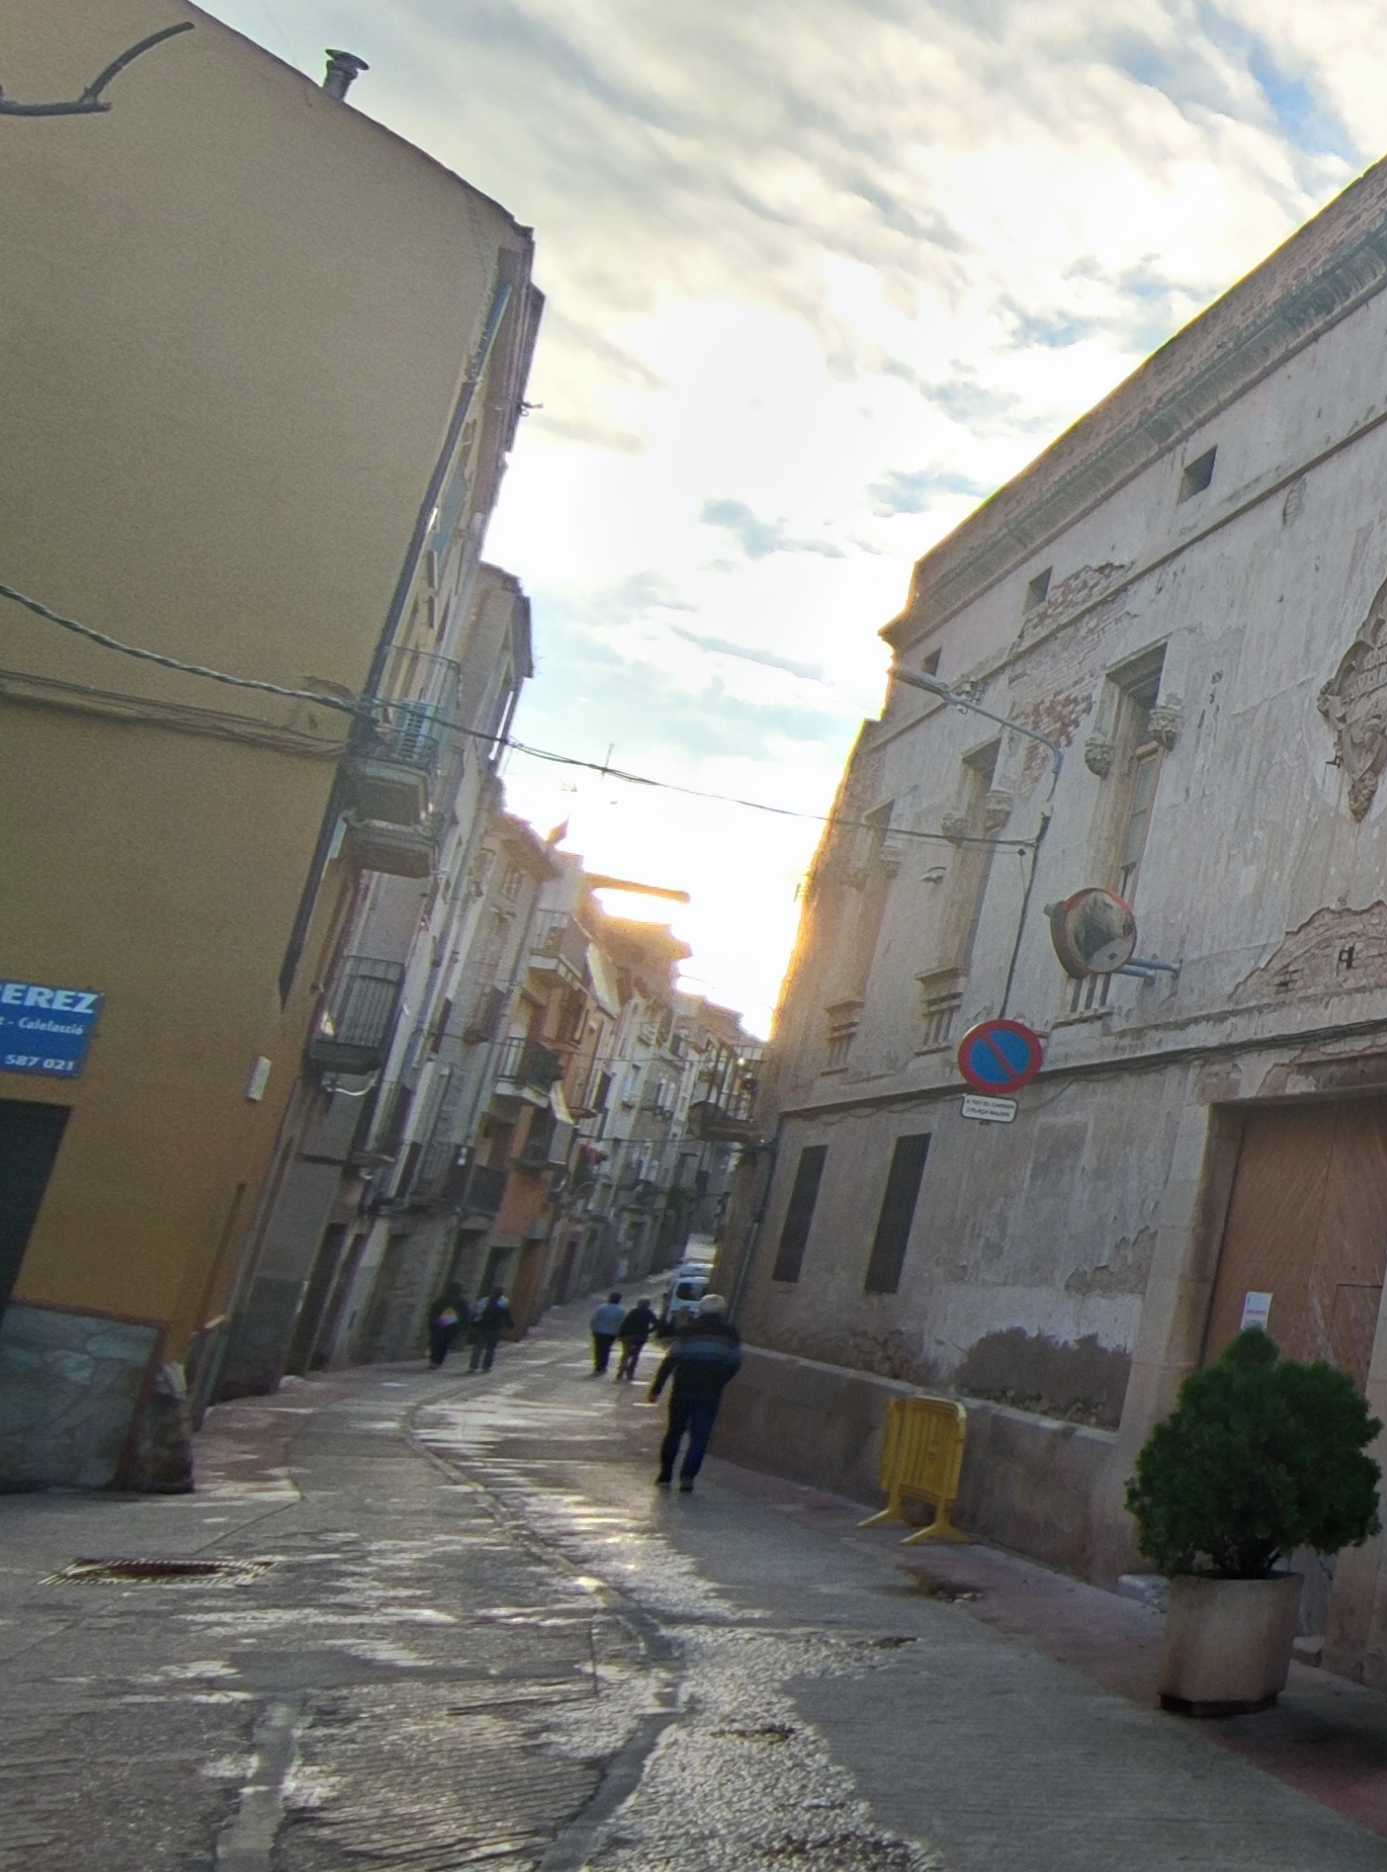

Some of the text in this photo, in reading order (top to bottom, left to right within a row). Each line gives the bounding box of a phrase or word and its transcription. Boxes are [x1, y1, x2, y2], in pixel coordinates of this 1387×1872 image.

[0, 983, 99, 1015] EREZ
[4, 1054, 75, 1071] 587 021
